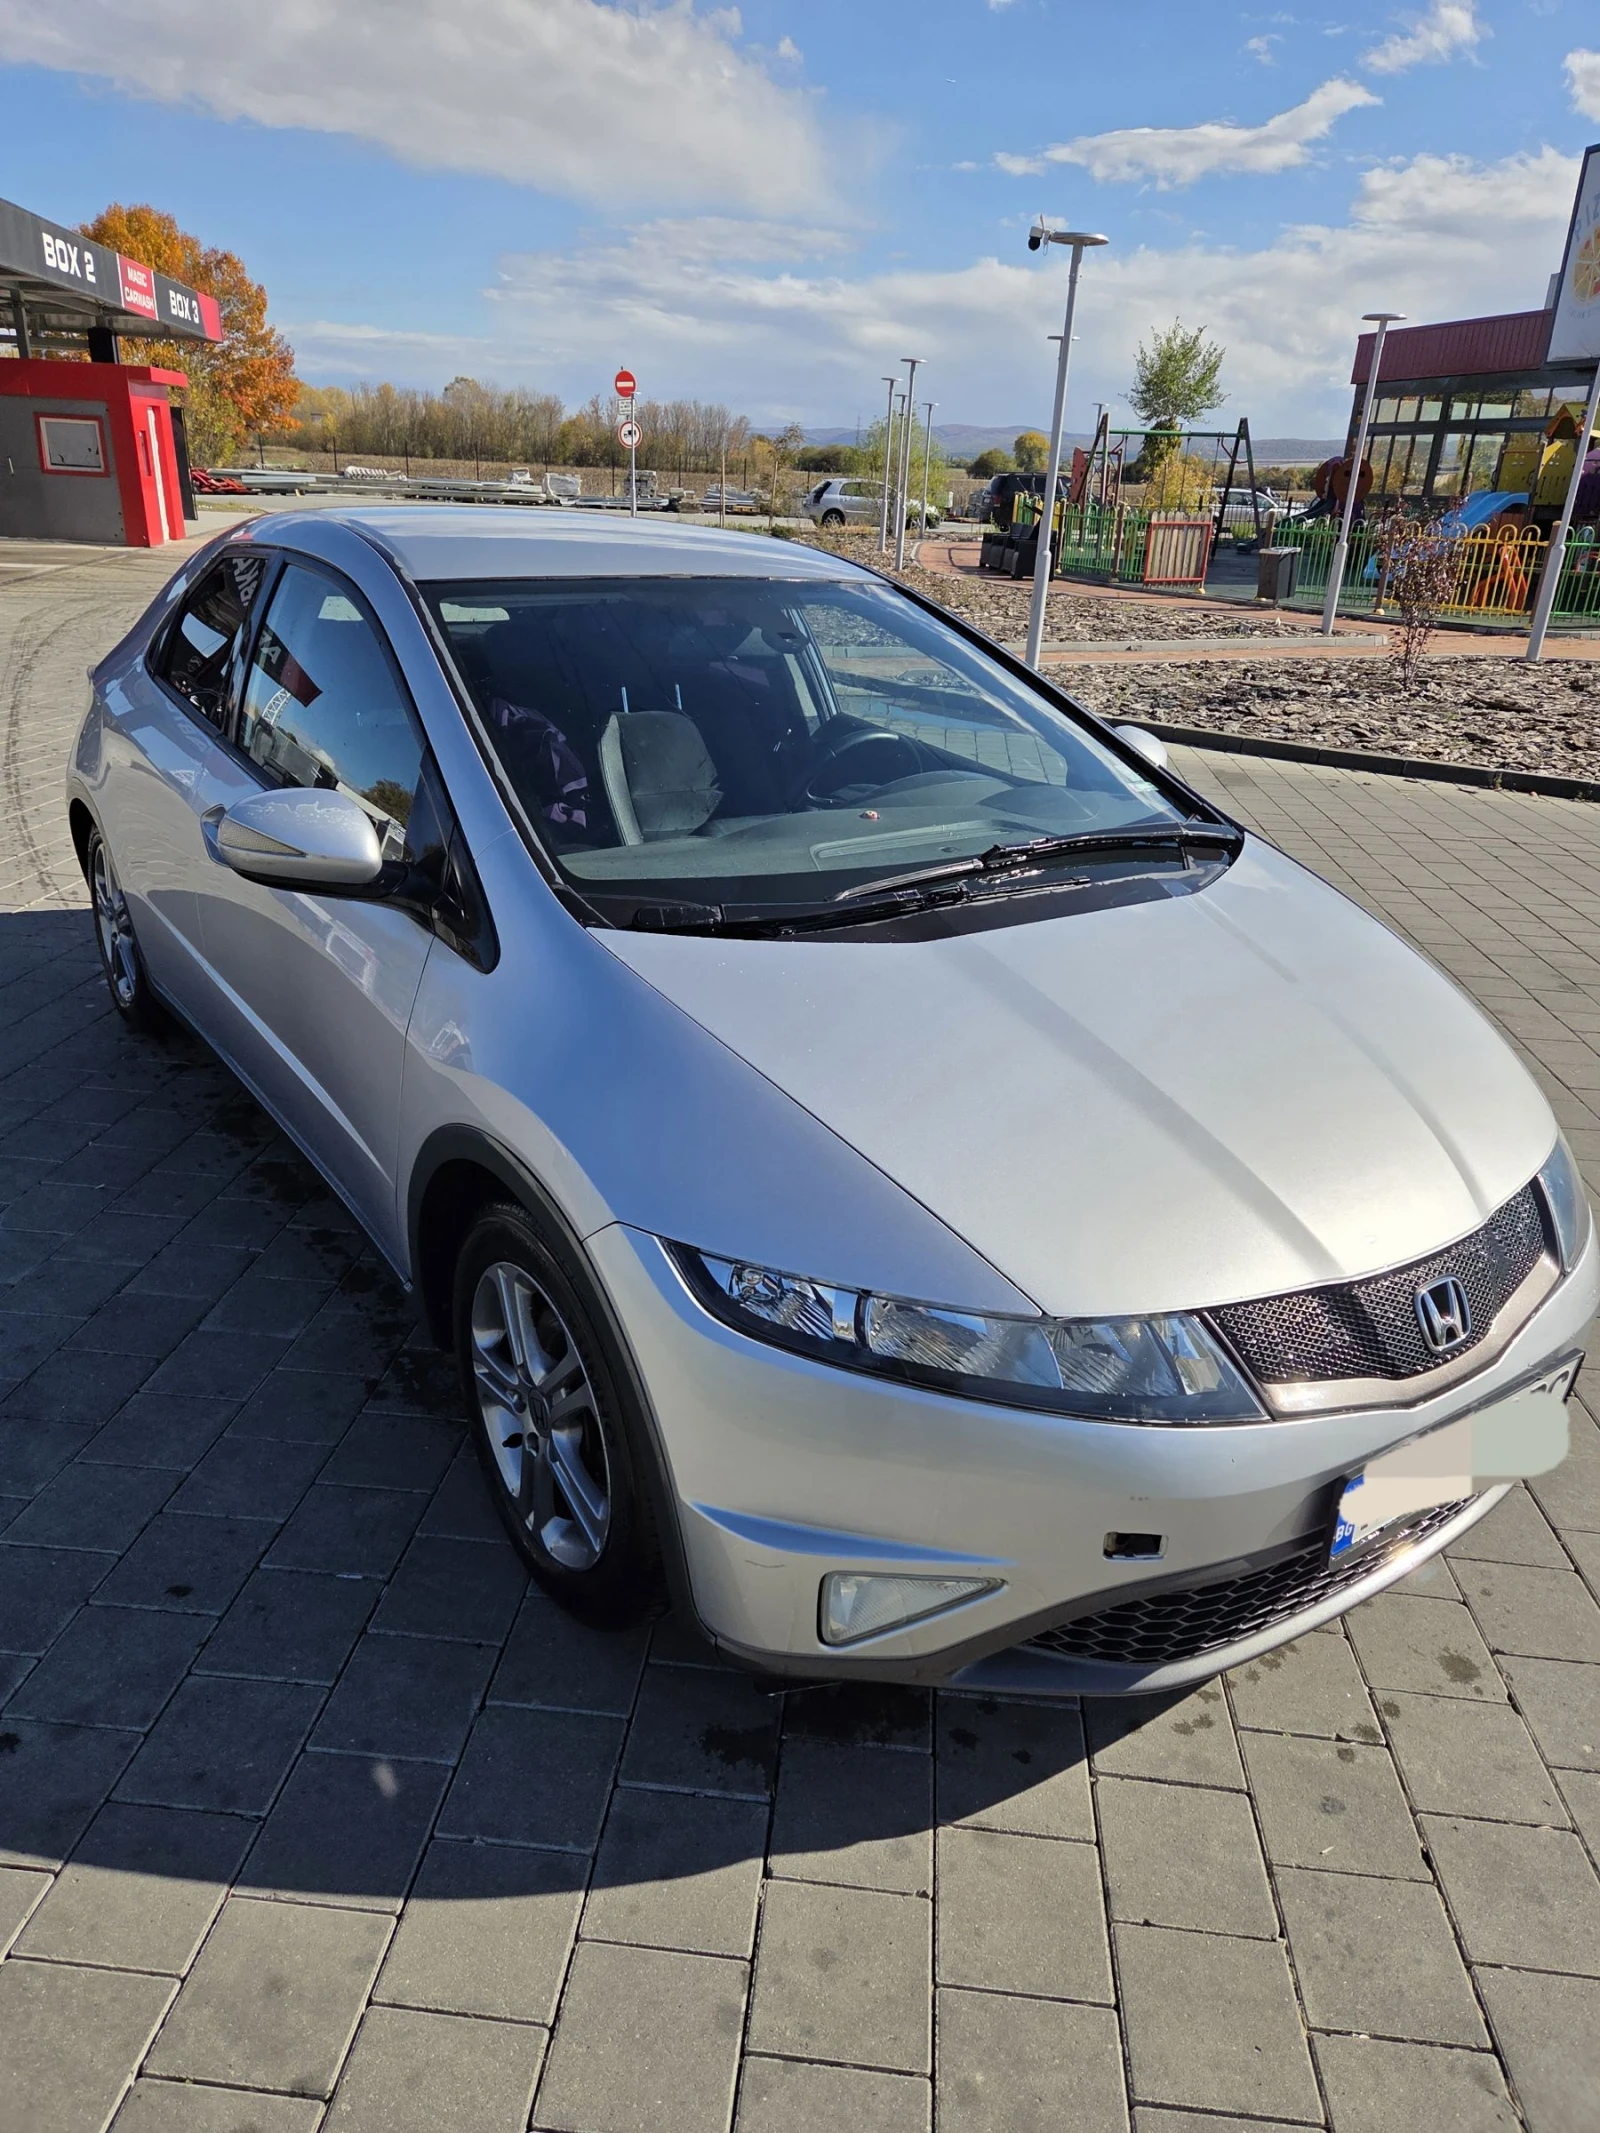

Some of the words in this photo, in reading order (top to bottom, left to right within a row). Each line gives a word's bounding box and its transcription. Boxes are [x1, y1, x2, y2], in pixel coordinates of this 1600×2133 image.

[42, 231, 82, 278] BOX
[83, 250, 97, 284] 2
[127, 265, 148, 288] MAGIC
[124, 286, 155, 312] CARWASH
[168, 289, 192, 321] BOX
[191, 300, 200, 324] 3
[1335, 1522, 1354, 1543] BG
